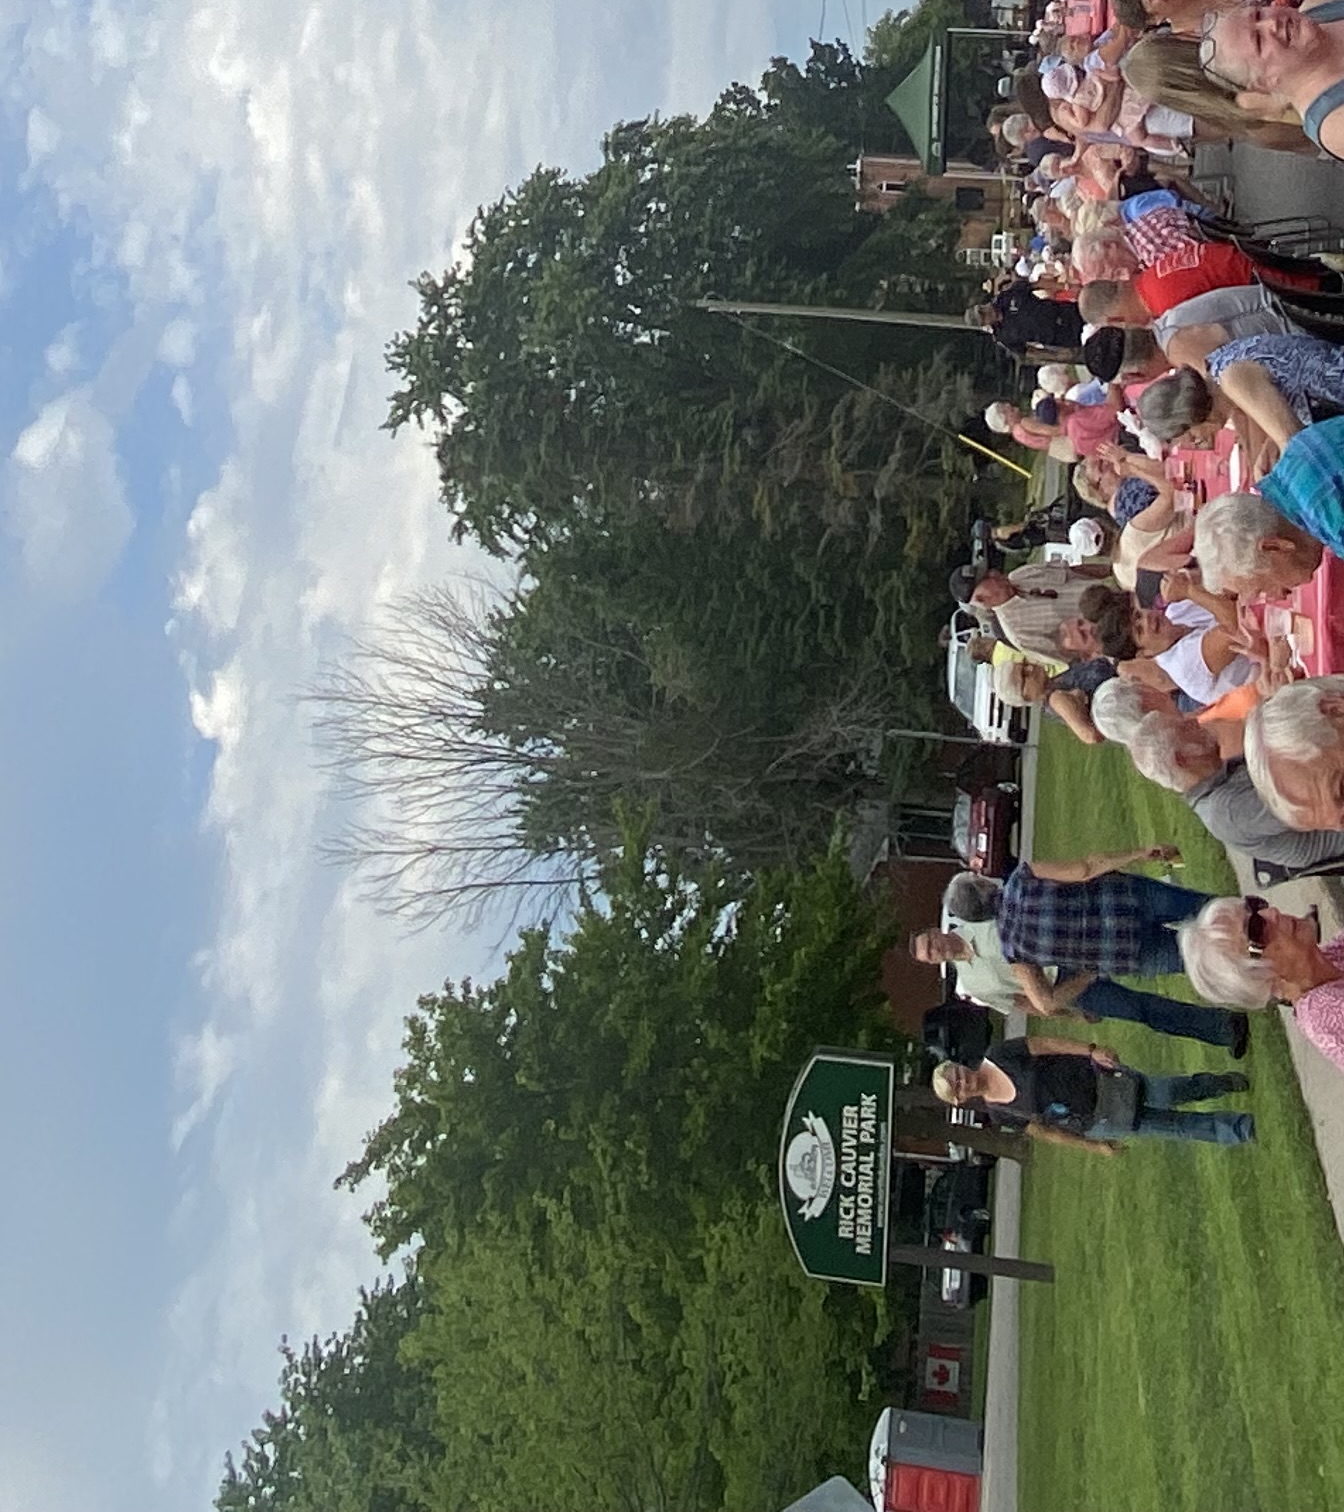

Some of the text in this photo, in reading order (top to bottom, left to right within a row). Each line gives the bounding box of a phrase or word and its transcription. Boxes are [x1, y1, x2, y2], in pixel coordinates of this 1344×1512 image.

[817, 1142, 834, 1200] WELCOME
[838, 1105, 859, 1239] RICK CAUVIER
[856, 1093, 876, 1254] MEMORIAL PARK
